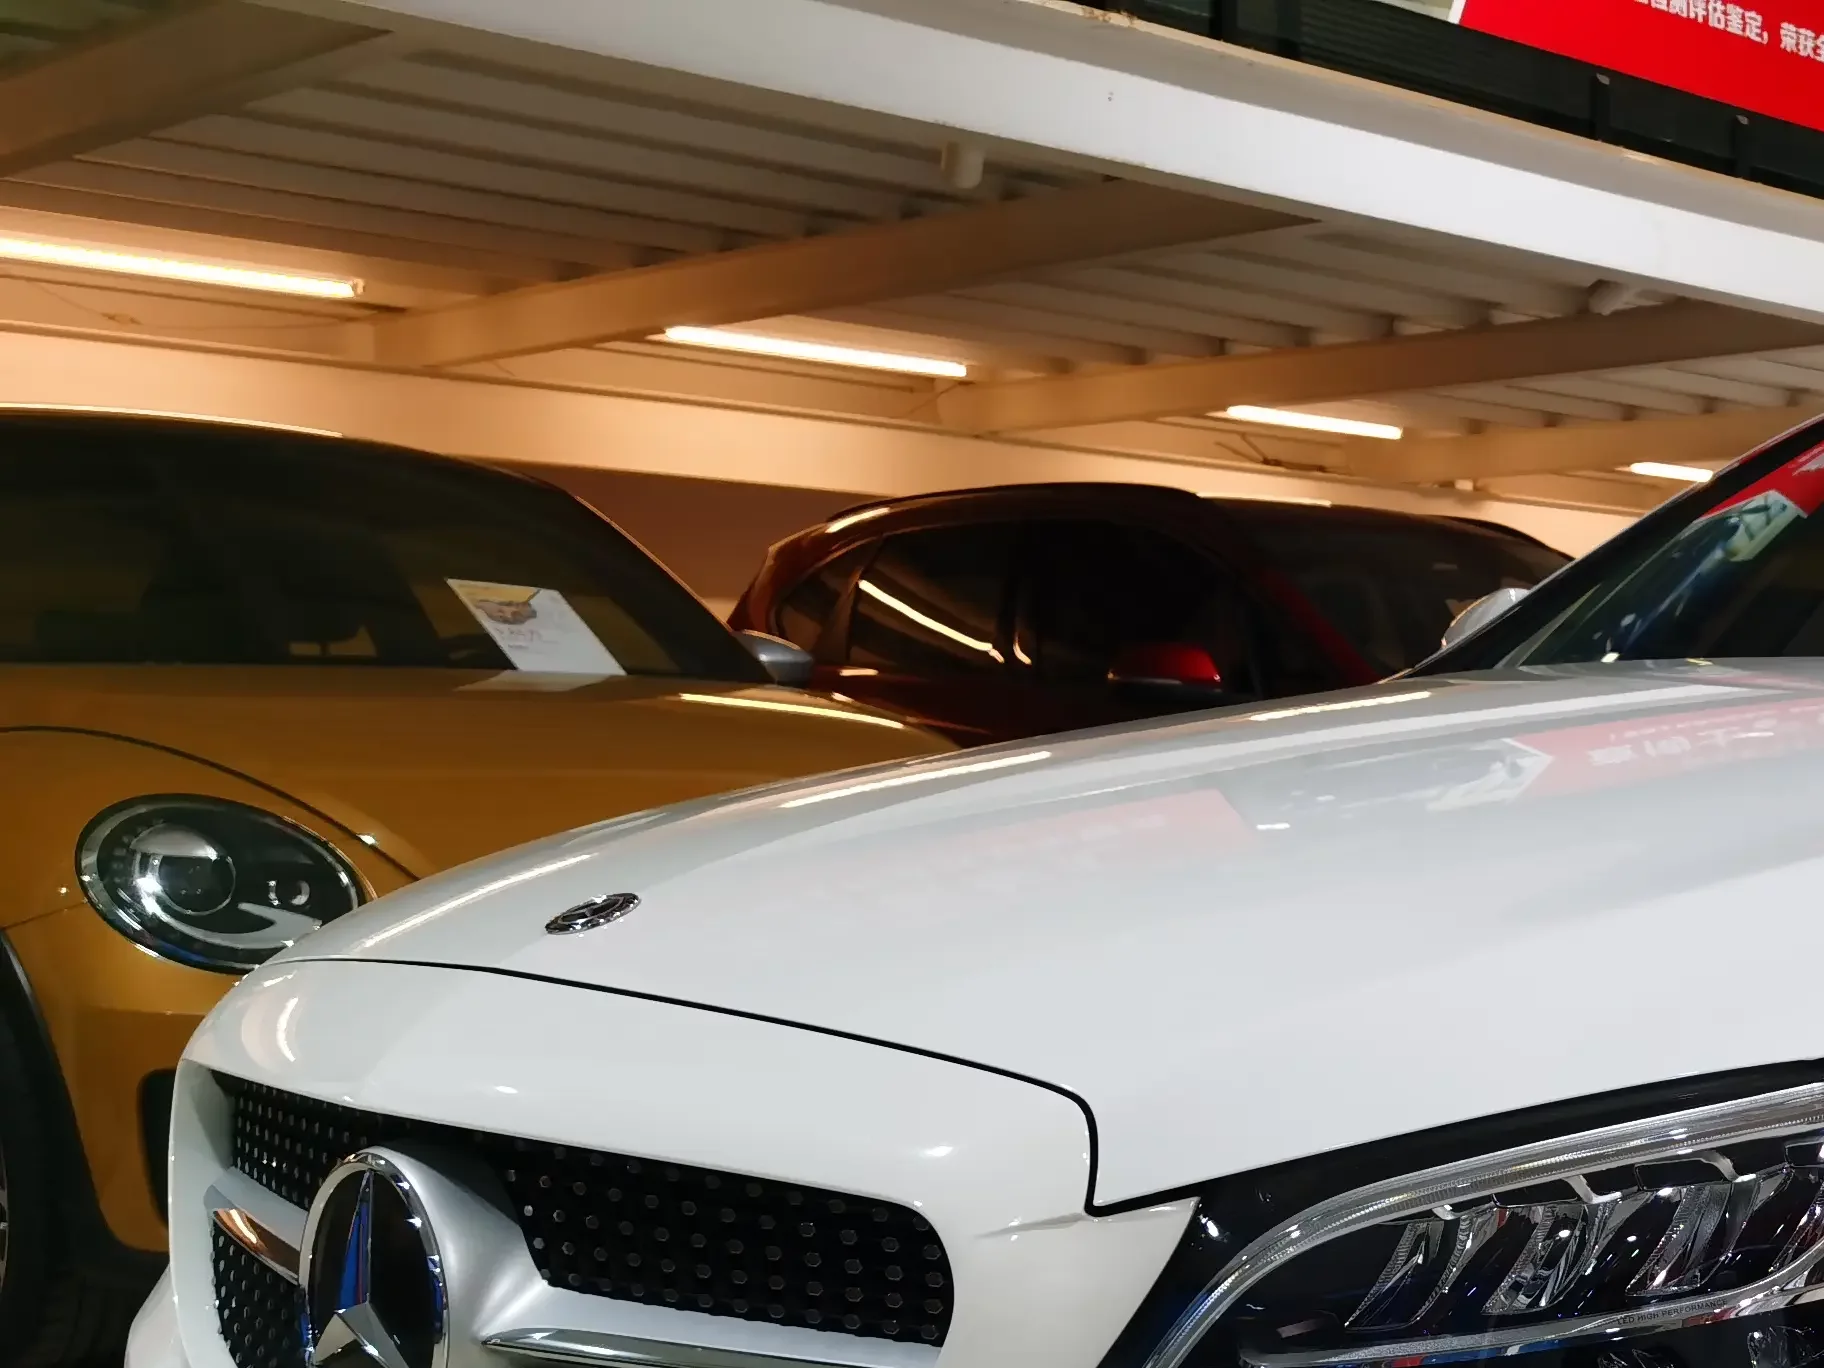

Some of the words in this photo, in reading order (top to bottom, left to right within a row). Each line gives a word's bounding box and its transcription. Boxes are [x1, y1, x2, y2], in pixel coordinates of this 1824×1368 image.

[1617, 1316, 1635, 1325] LED
[1637, 1313, 1660, 1322] HIGH
[1662, 1299, 1728, 1316] PERFORMANCE
